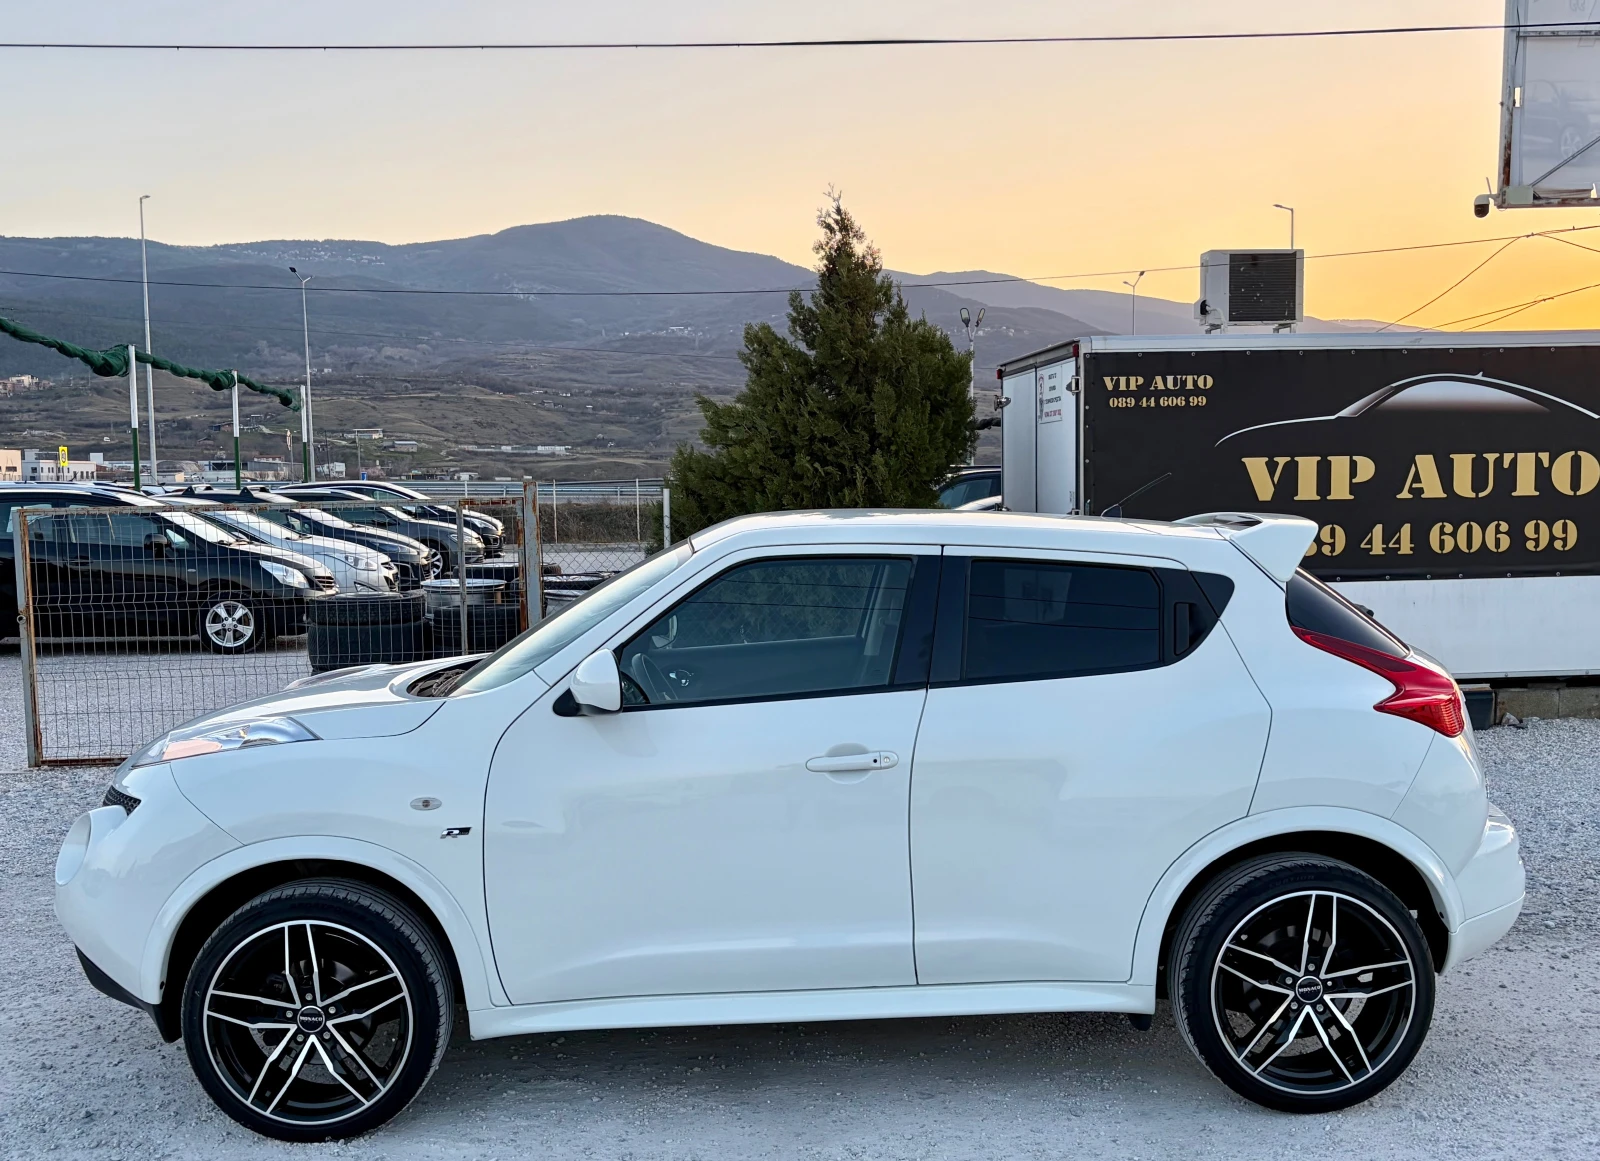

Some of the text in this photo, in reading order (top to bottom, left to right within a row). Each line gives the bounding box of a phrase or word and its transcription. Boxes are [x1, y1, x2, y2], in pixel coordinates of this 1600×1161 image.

[1102, 374, 1214, 391] VIP AUTO
[1109, 395, 1207, 408] 089 44 606 99
[1242, 450, 1600, 501] VIP AUTO
[1360, 524, 1414, 556] 44
[1430, 522, 1511, 554] 606
[1525, 519, 1578, 552] 99
